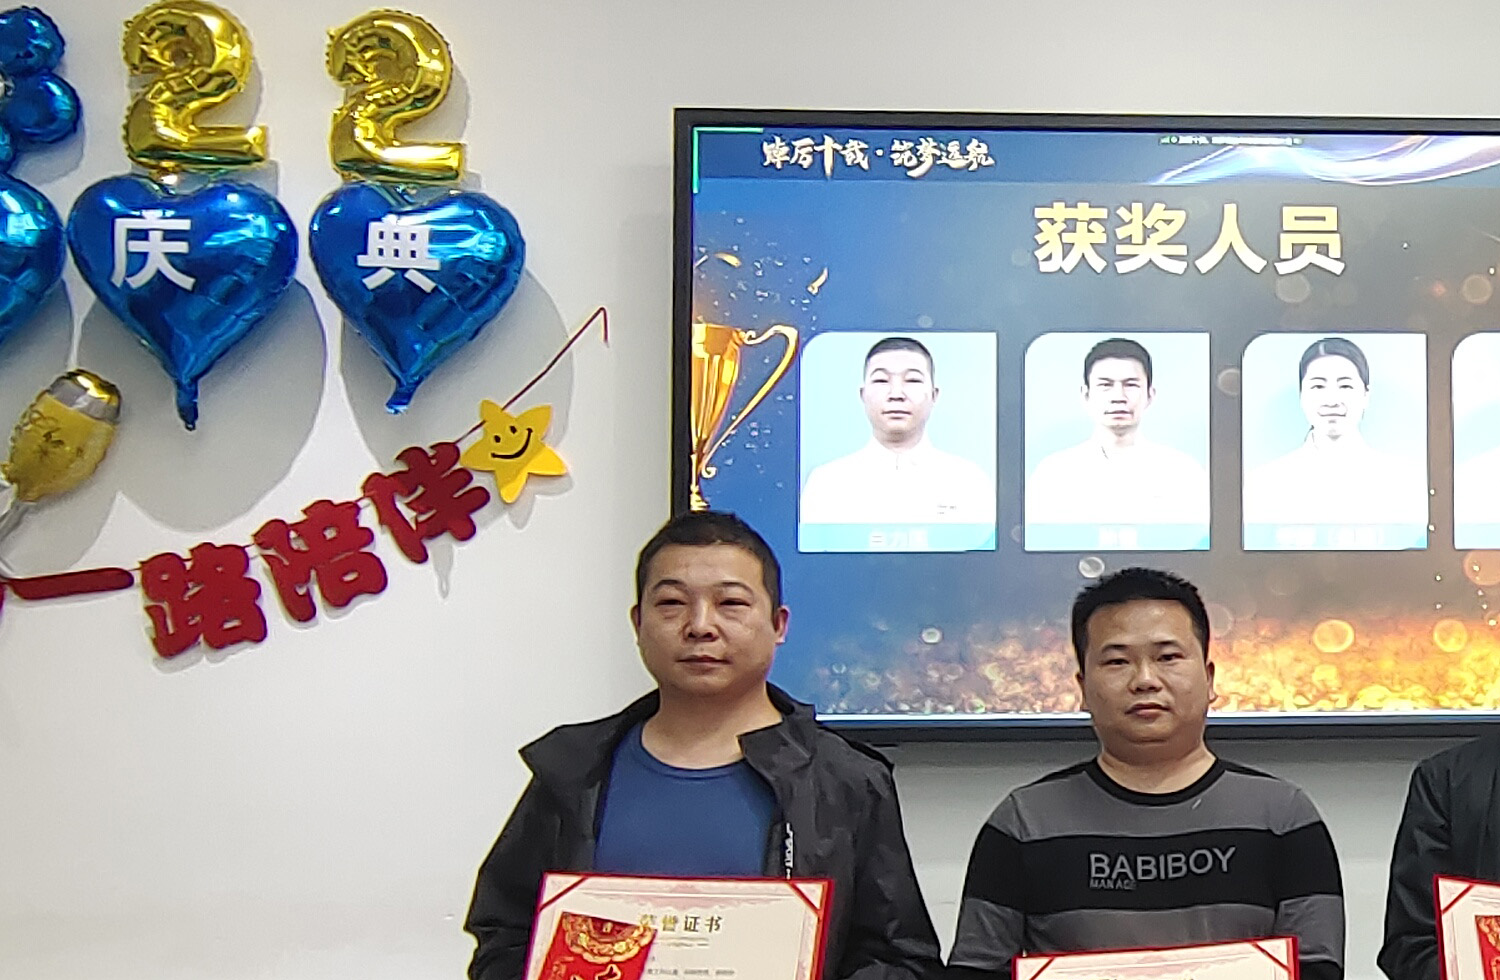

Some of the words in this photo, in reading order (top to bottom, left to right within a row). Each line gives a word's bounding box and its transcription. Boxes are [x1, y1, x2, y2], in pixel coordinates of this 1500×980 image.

[122, 0, 267, 168] 2
[325, 8, 465, 181] 2
[111, 214, 196, 291] 庆
[356, 219, 441, 293] 典
[1033, 201, 1346, 276] 获奖人员
[1089, 847, 1236, 880] BABIBOY
